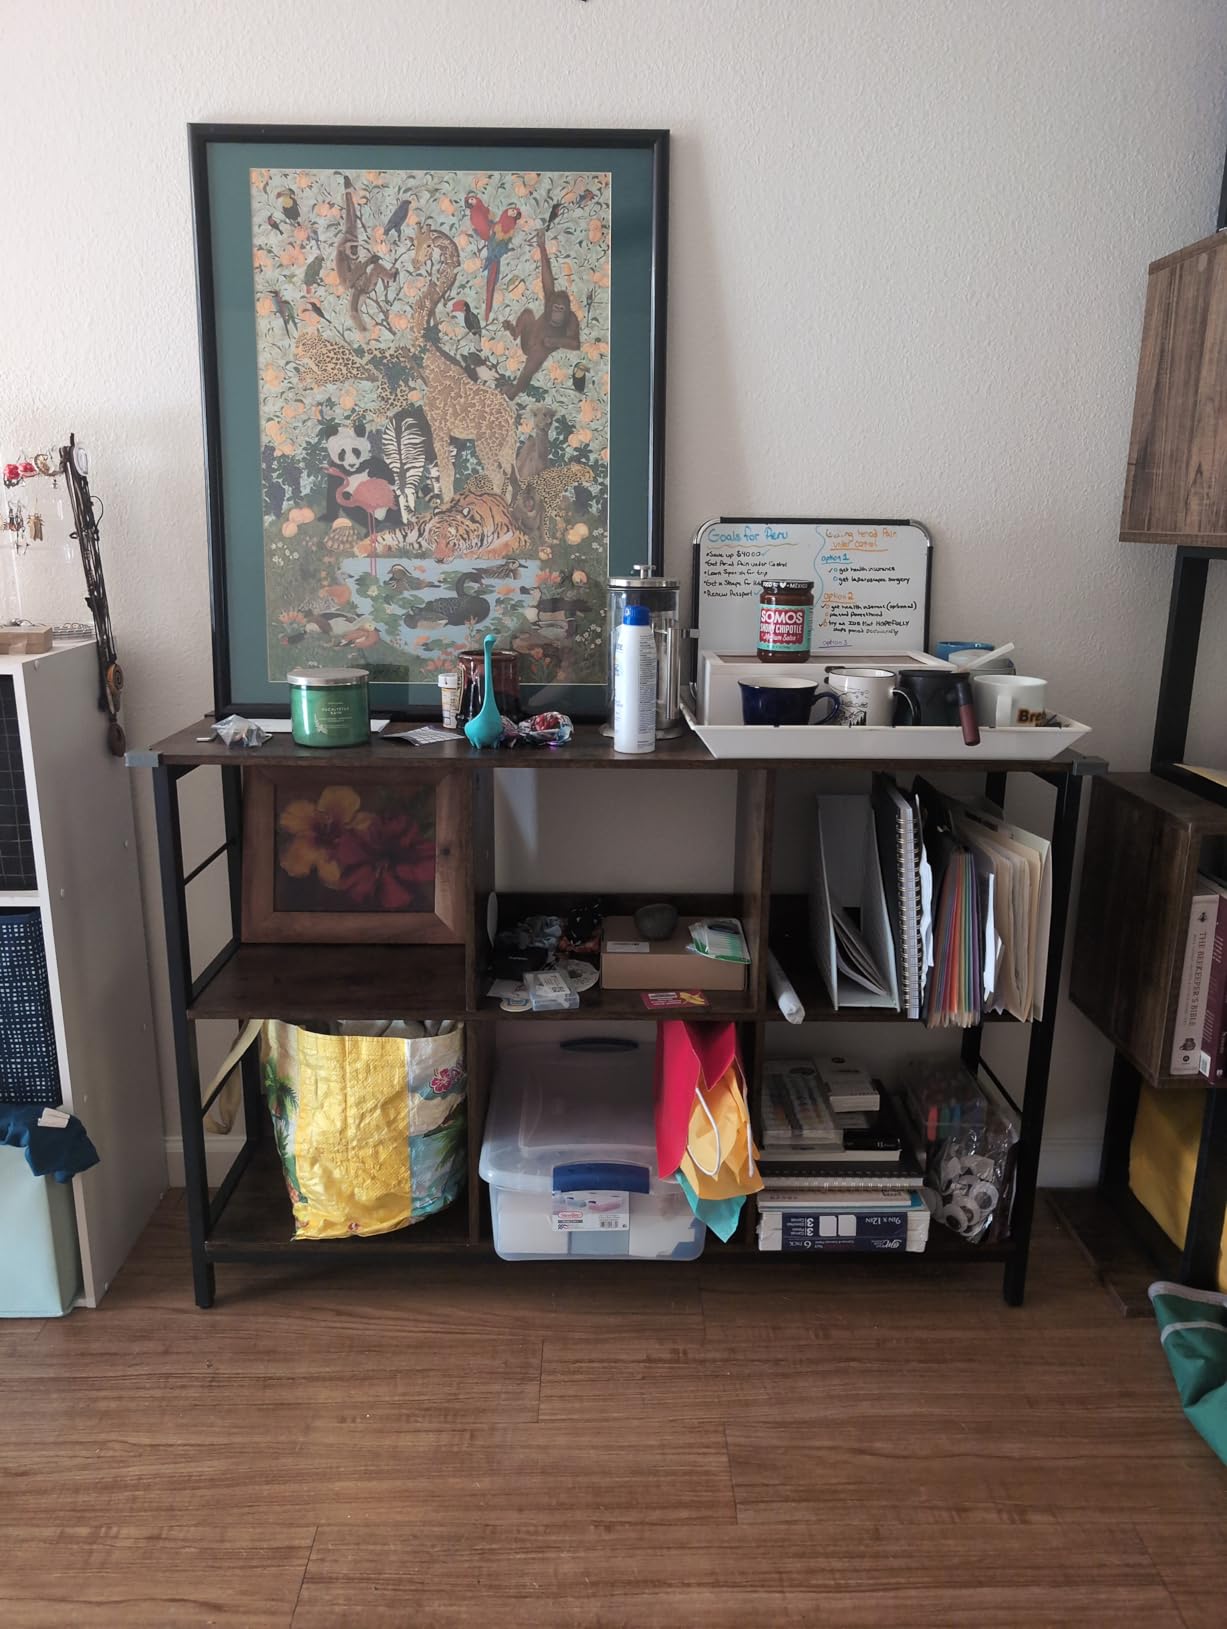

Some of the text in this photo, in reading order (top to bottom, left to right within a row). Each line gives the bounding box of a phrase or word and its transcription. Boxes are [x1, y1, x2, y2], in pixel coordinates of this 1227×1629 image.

[708, 525, 789, 543] Goals for Peru
[725, 552, 735, 560] up
[736, 550, 761, 558] $4000
[842, 553, 850, 561] 1
[847, 591, 854, 600] 2
[760, 610, 804, 624] SOMOS
[875, 619, 910, 627] HOPEFULLY
[775, 623, 803, 634] CHIPOTLE
[806, 1217, 815, 1228] 3
[806, 1227, 815, 1237] 3
[803, 1240, 812, 1249] 6
